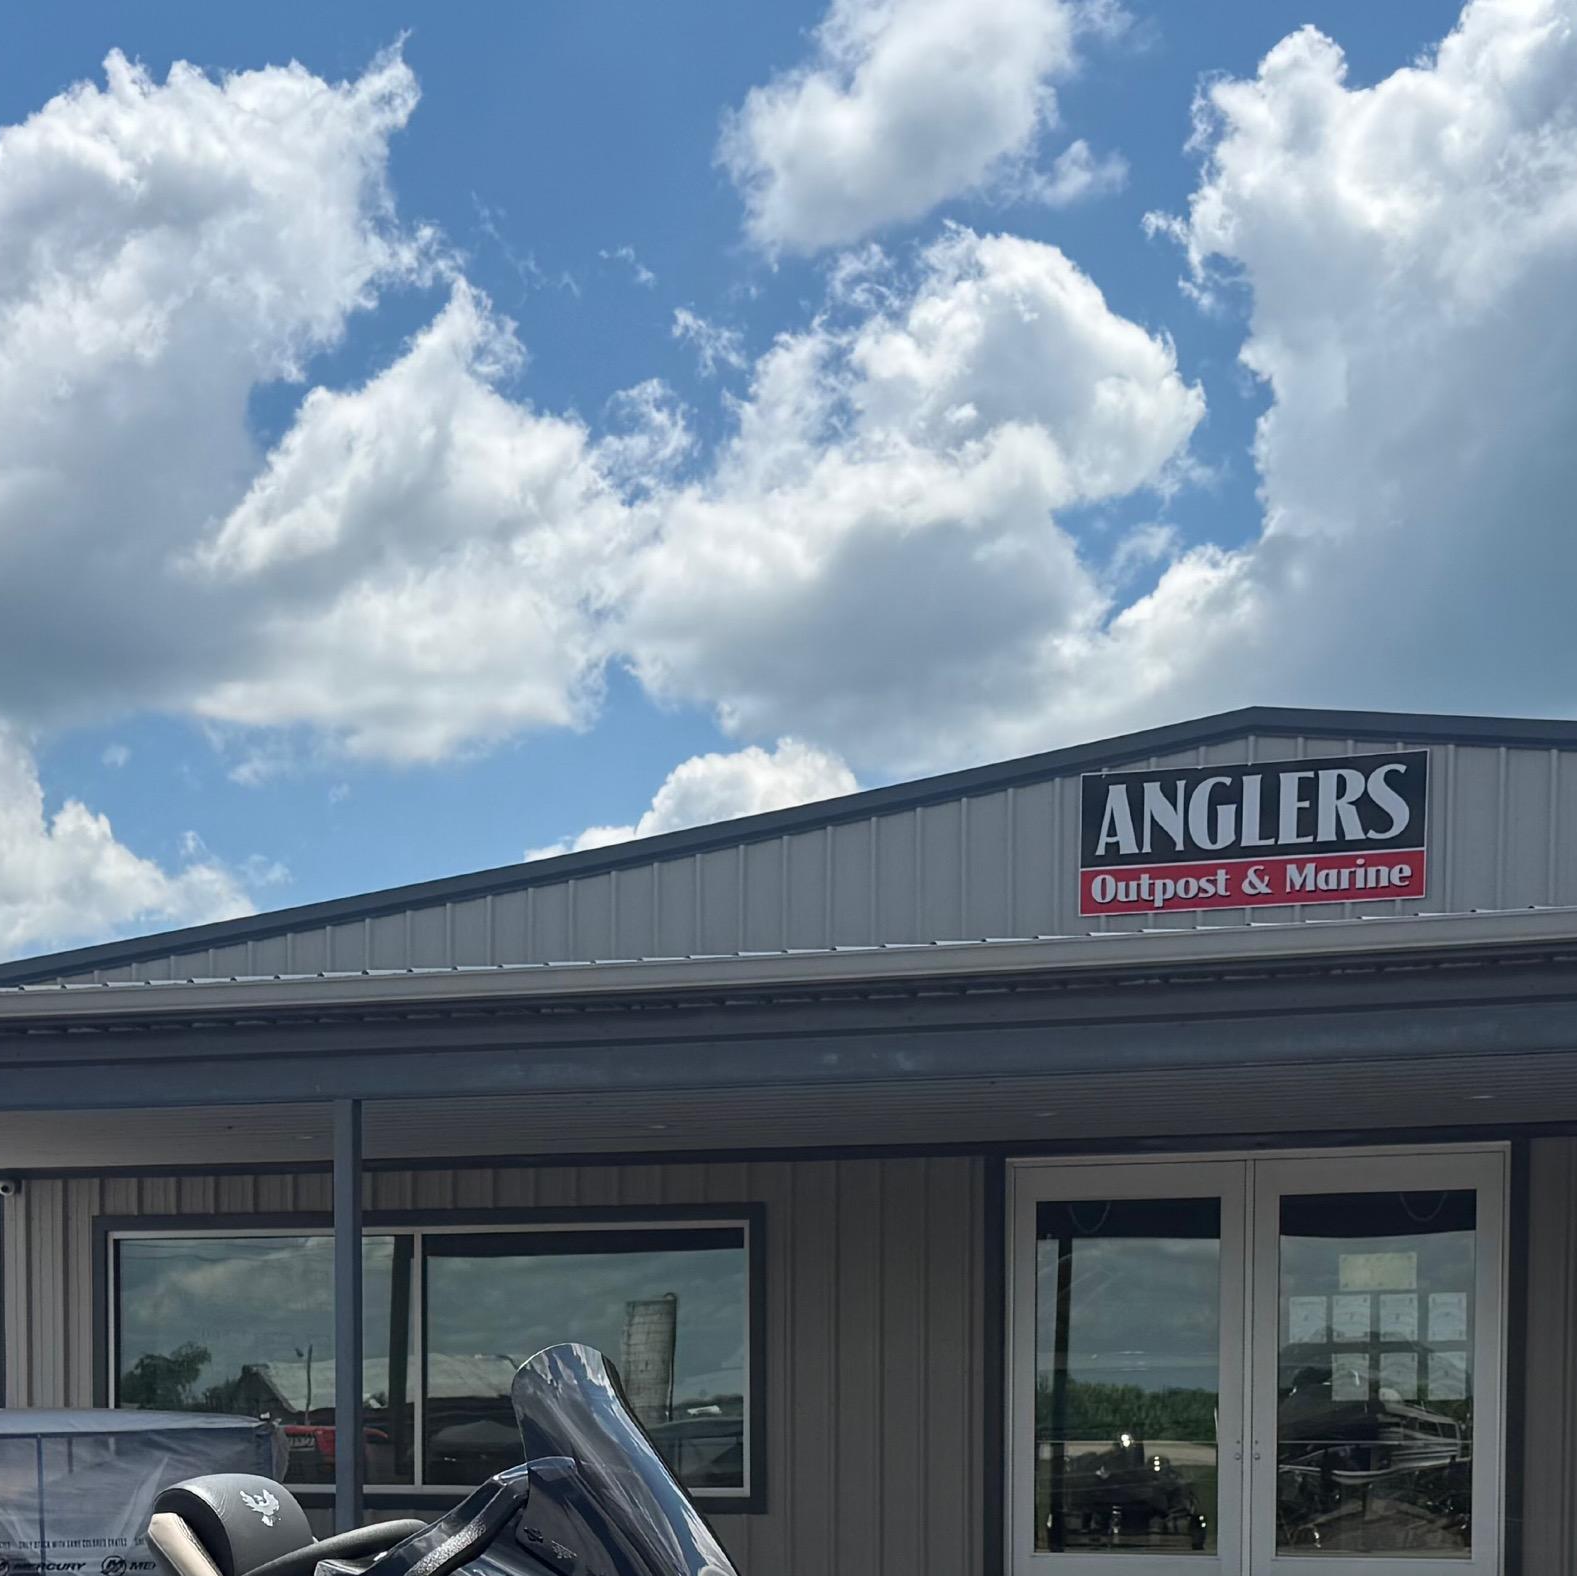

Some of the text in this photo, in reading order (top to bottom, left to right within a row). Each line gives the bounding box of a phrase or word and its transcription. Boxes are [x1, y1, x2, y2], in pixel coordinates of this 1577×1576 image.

[1094, 763, 1411, 856] ANGLERS
[1091, 858, 1412, 907] Outpost & Marine
[14, 1562, 86, 1571] MERCURY
